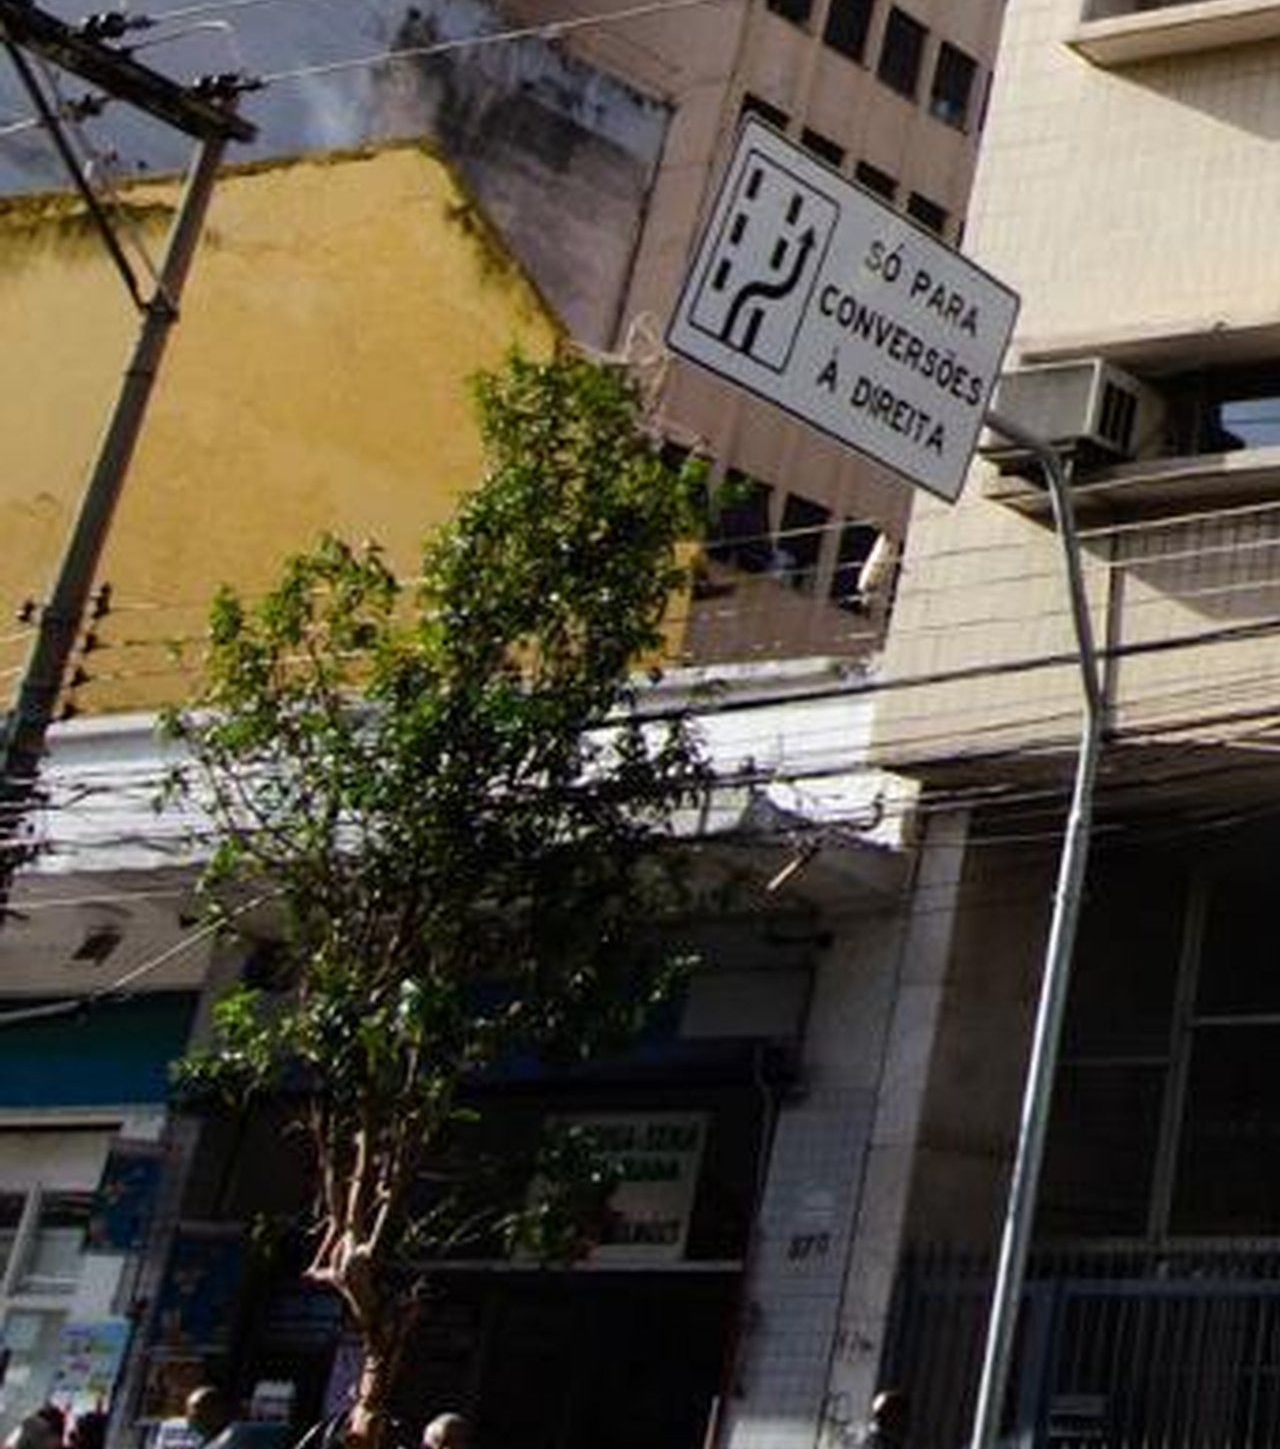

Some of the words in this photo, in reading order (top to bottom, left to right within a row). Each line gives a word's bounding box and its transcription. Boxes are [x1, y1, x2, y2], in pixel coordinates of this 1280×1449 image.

[865, 240, 904, 282] SÓ
[910, 270, 978, 336] PARA
[820, 285, 982, 407] CONVERSÕES
[850, 376, 944, 455] DIREITA
